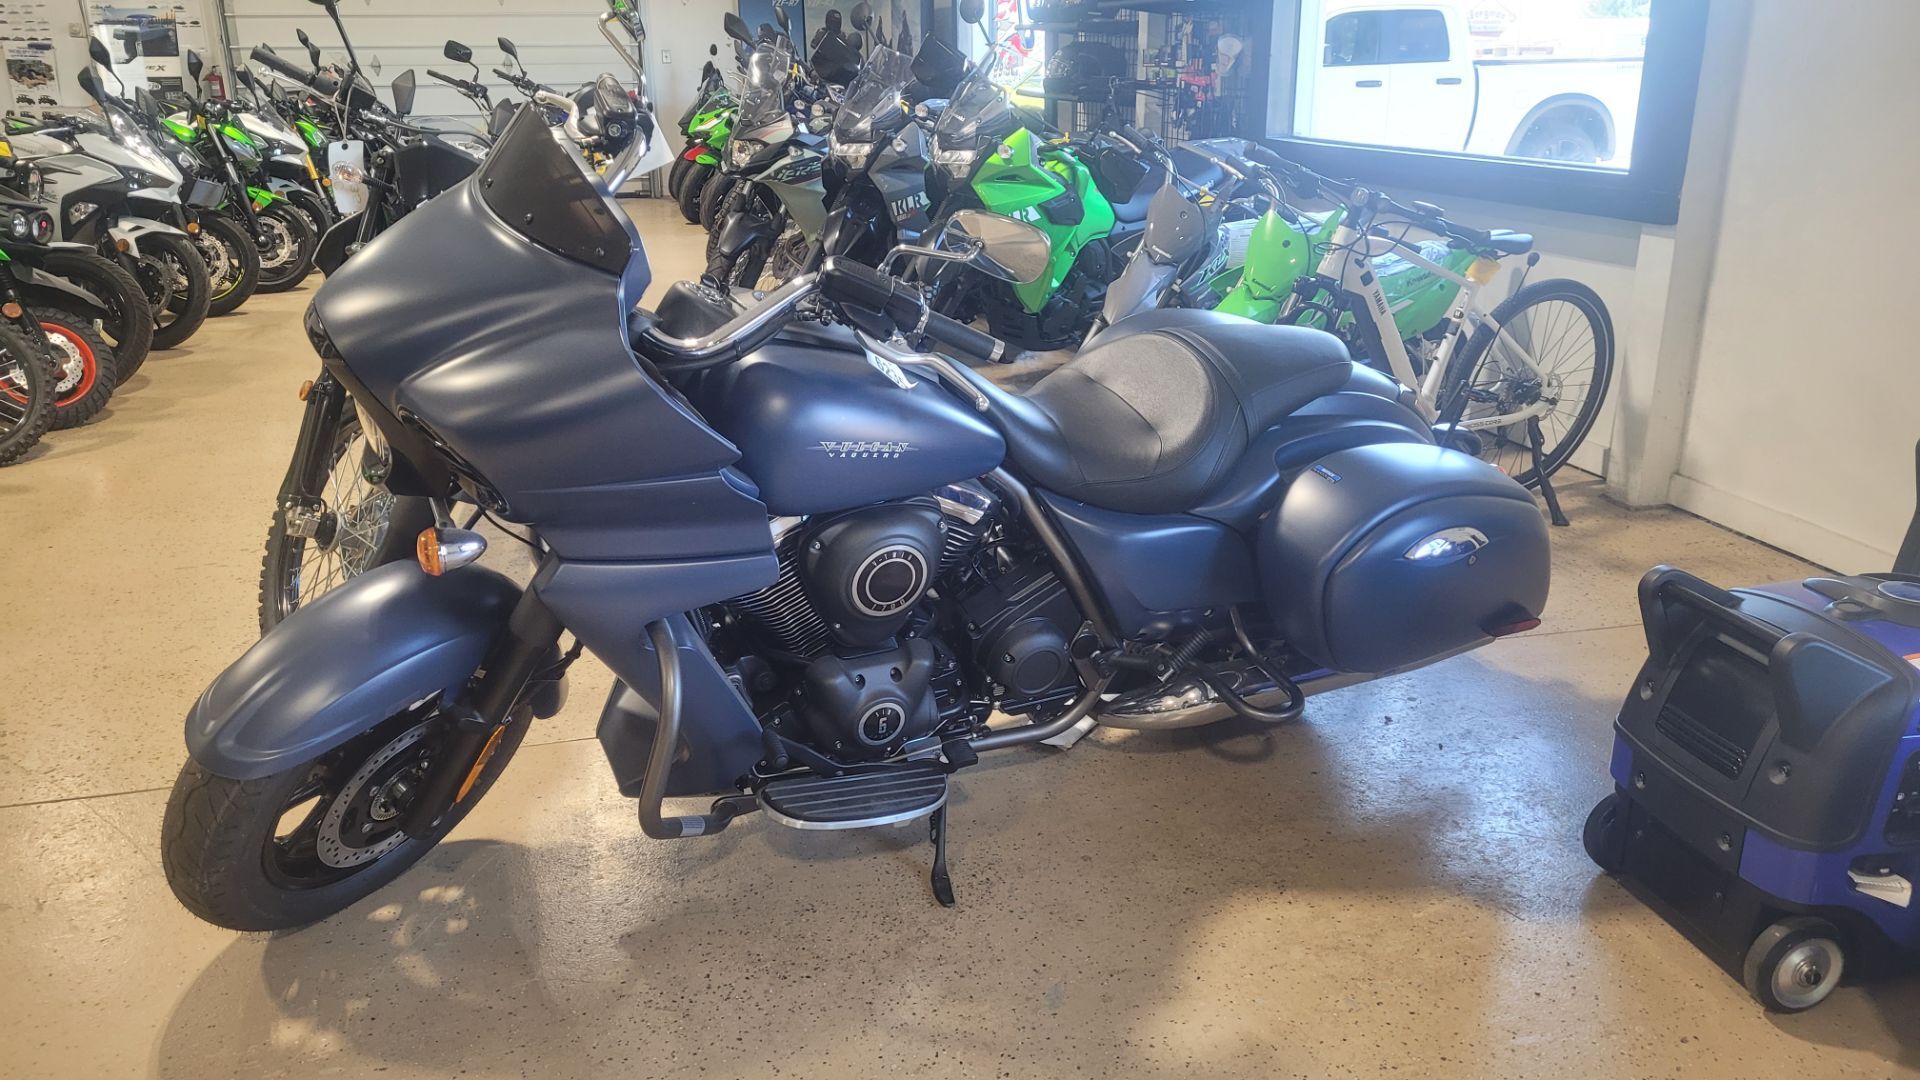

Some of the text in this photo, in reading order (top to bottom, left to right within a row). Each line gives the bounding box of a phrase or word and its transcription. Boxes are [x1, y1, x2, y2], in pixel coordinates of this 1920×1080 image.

[891, 189, 928, 217] KLR
[1372, 289, 1387, 316] YAMAHA
[820, 441, 909, 452] VULCAN
[871, 551, 913, 567] V-TWIN
[871, 598, 906, 612] 1700
[878, 717, 888, 734] 6
